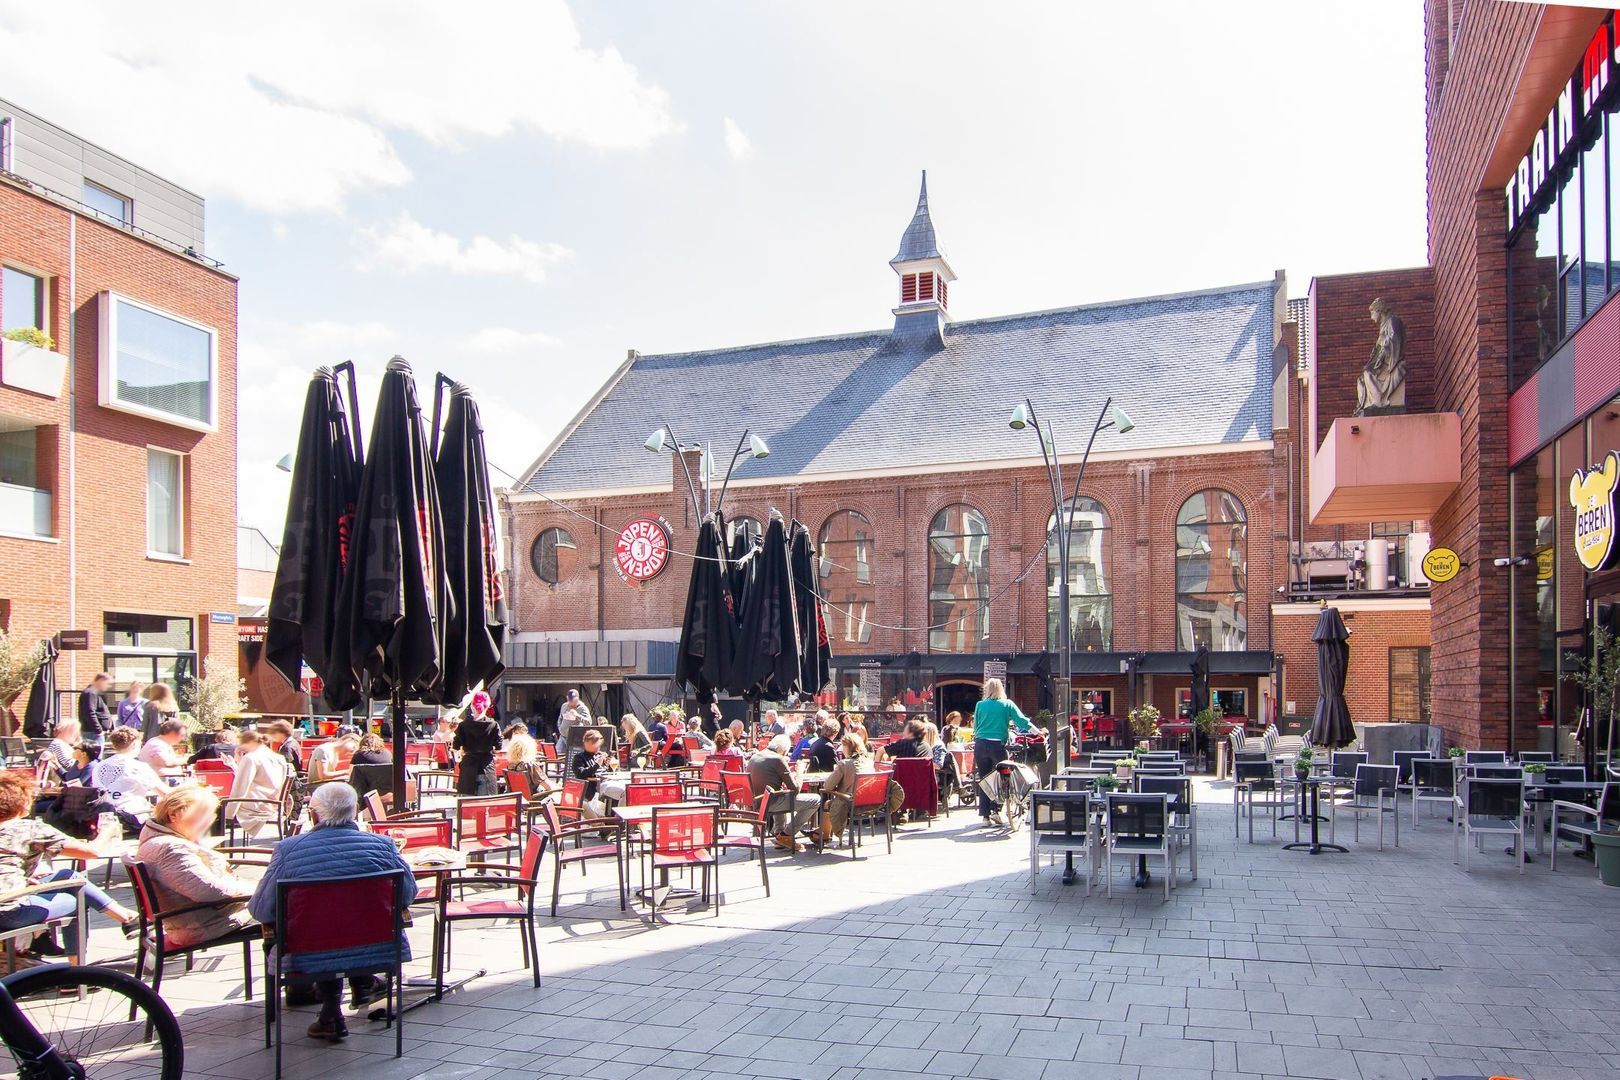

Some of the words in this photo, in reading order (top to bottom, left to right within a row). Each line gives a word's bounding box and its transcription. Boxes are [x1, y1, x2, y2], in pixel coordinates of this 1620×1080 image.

[1505, 78, 1574, 232] TRAIN
[617, 521, 660, 552] JOPEN
[1578, 504, 1607, 538] BEREN
[622, 547, 666, 577] JOPEN
